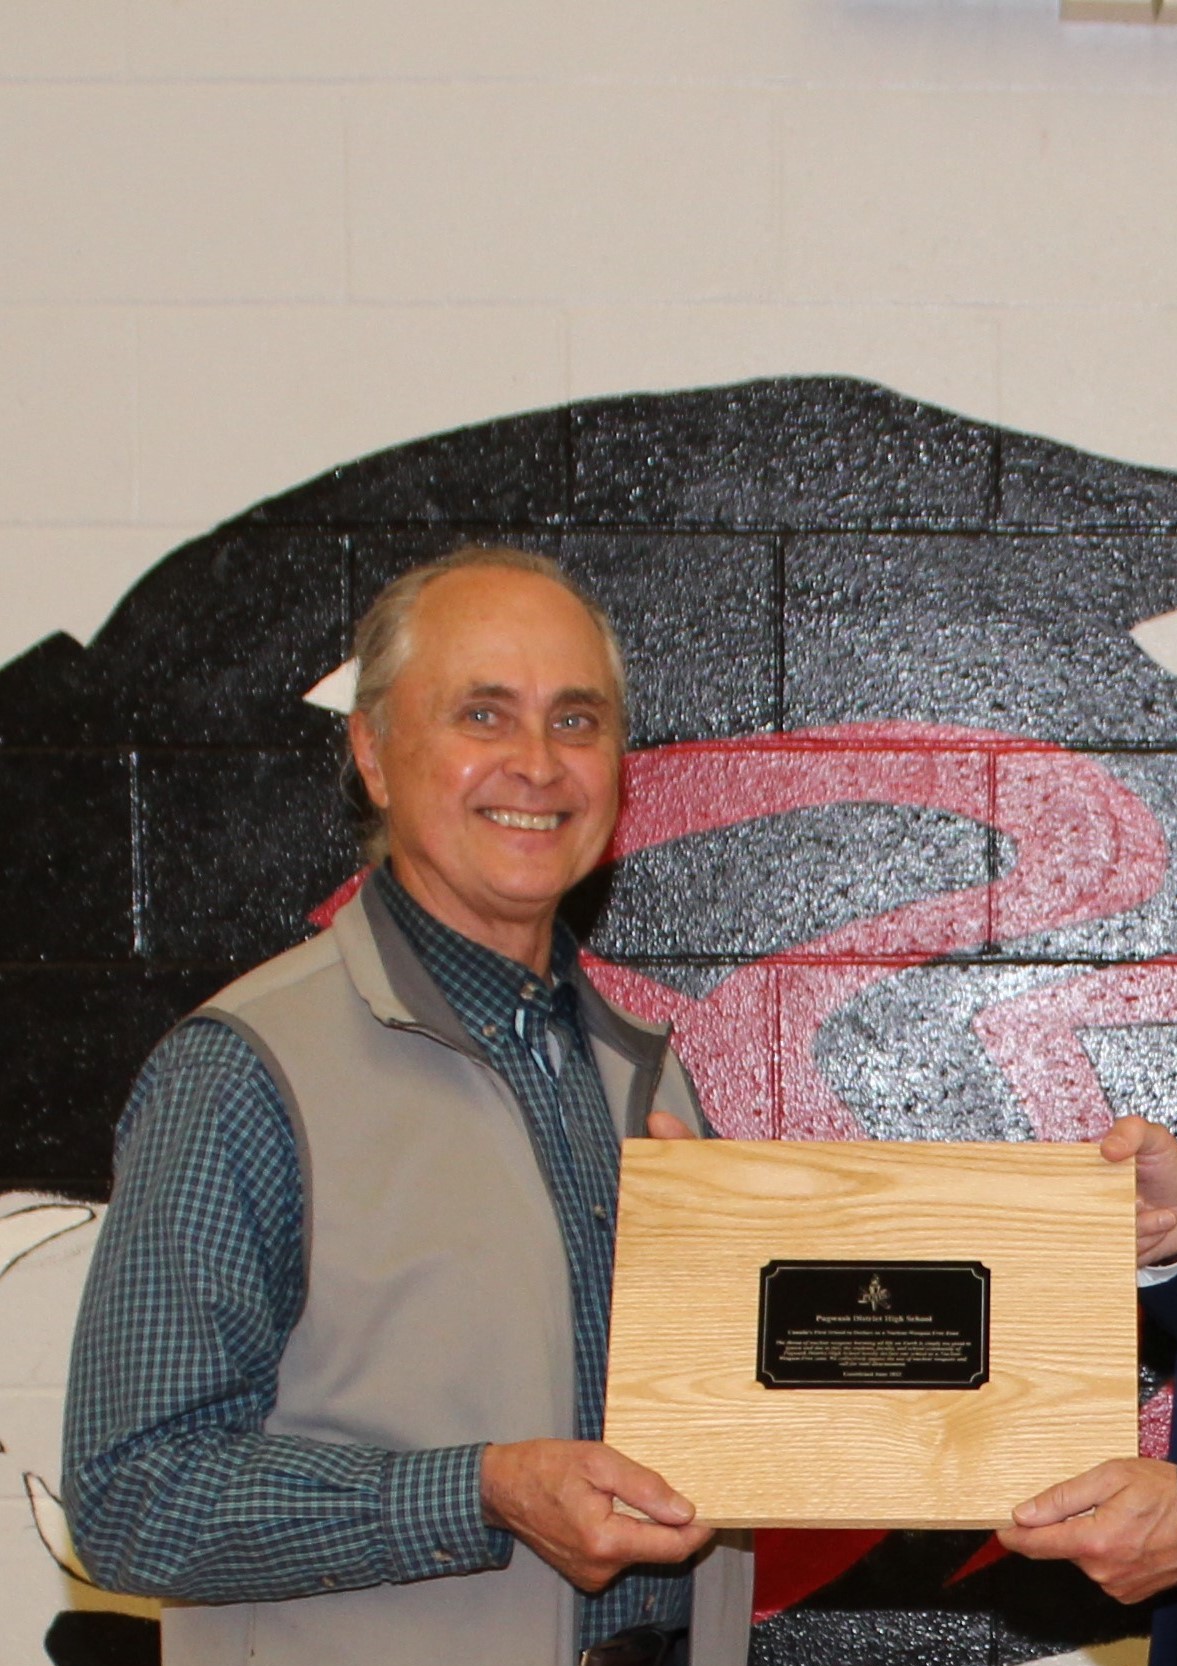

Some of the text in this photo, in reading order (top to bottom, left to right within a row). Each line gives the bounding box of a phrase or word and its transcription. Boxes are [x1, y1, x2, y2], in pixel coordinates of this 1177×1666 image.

[815, 1315, 933, 1324] Pugwash District High School
